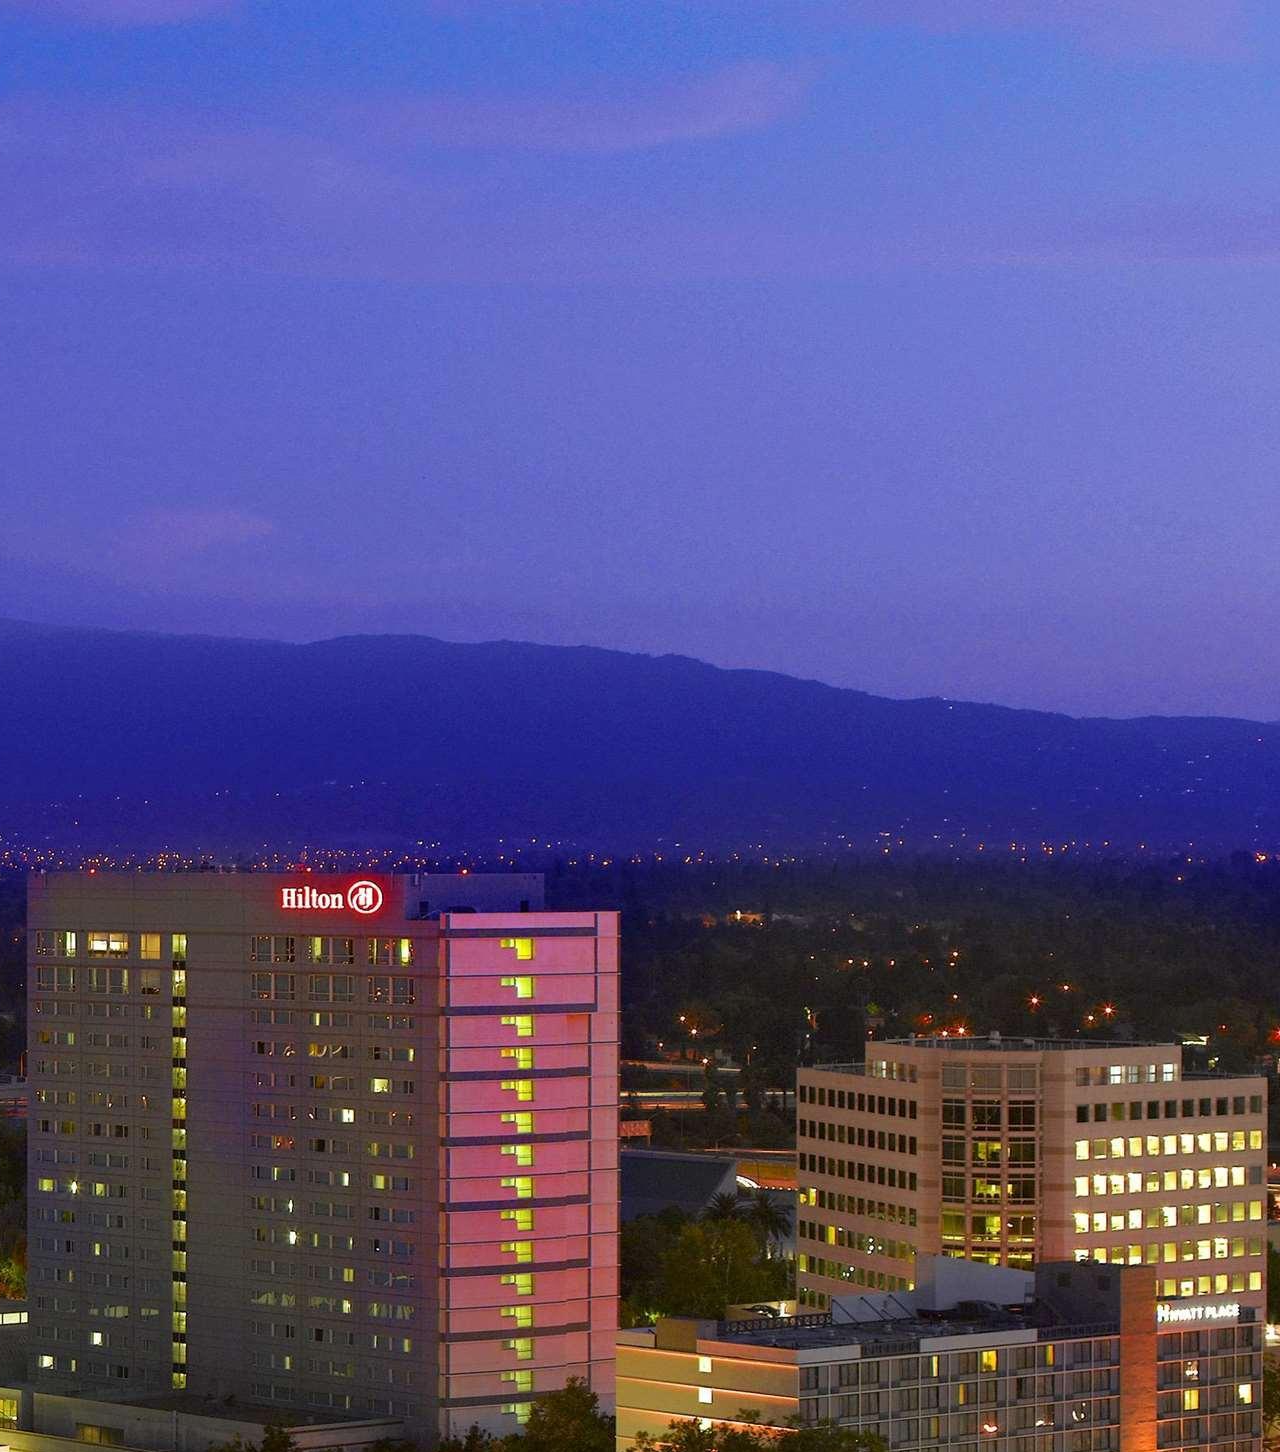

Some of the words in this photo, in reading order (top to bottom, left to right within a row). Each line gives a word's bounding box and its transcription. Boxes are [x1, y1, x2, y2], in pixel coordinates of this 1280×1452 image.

[281, 886, 344, 909] Hilton
[1157, 1304, 1204, 1322] HYATT
[1205, 1303, 1240, 1319] PLACE
